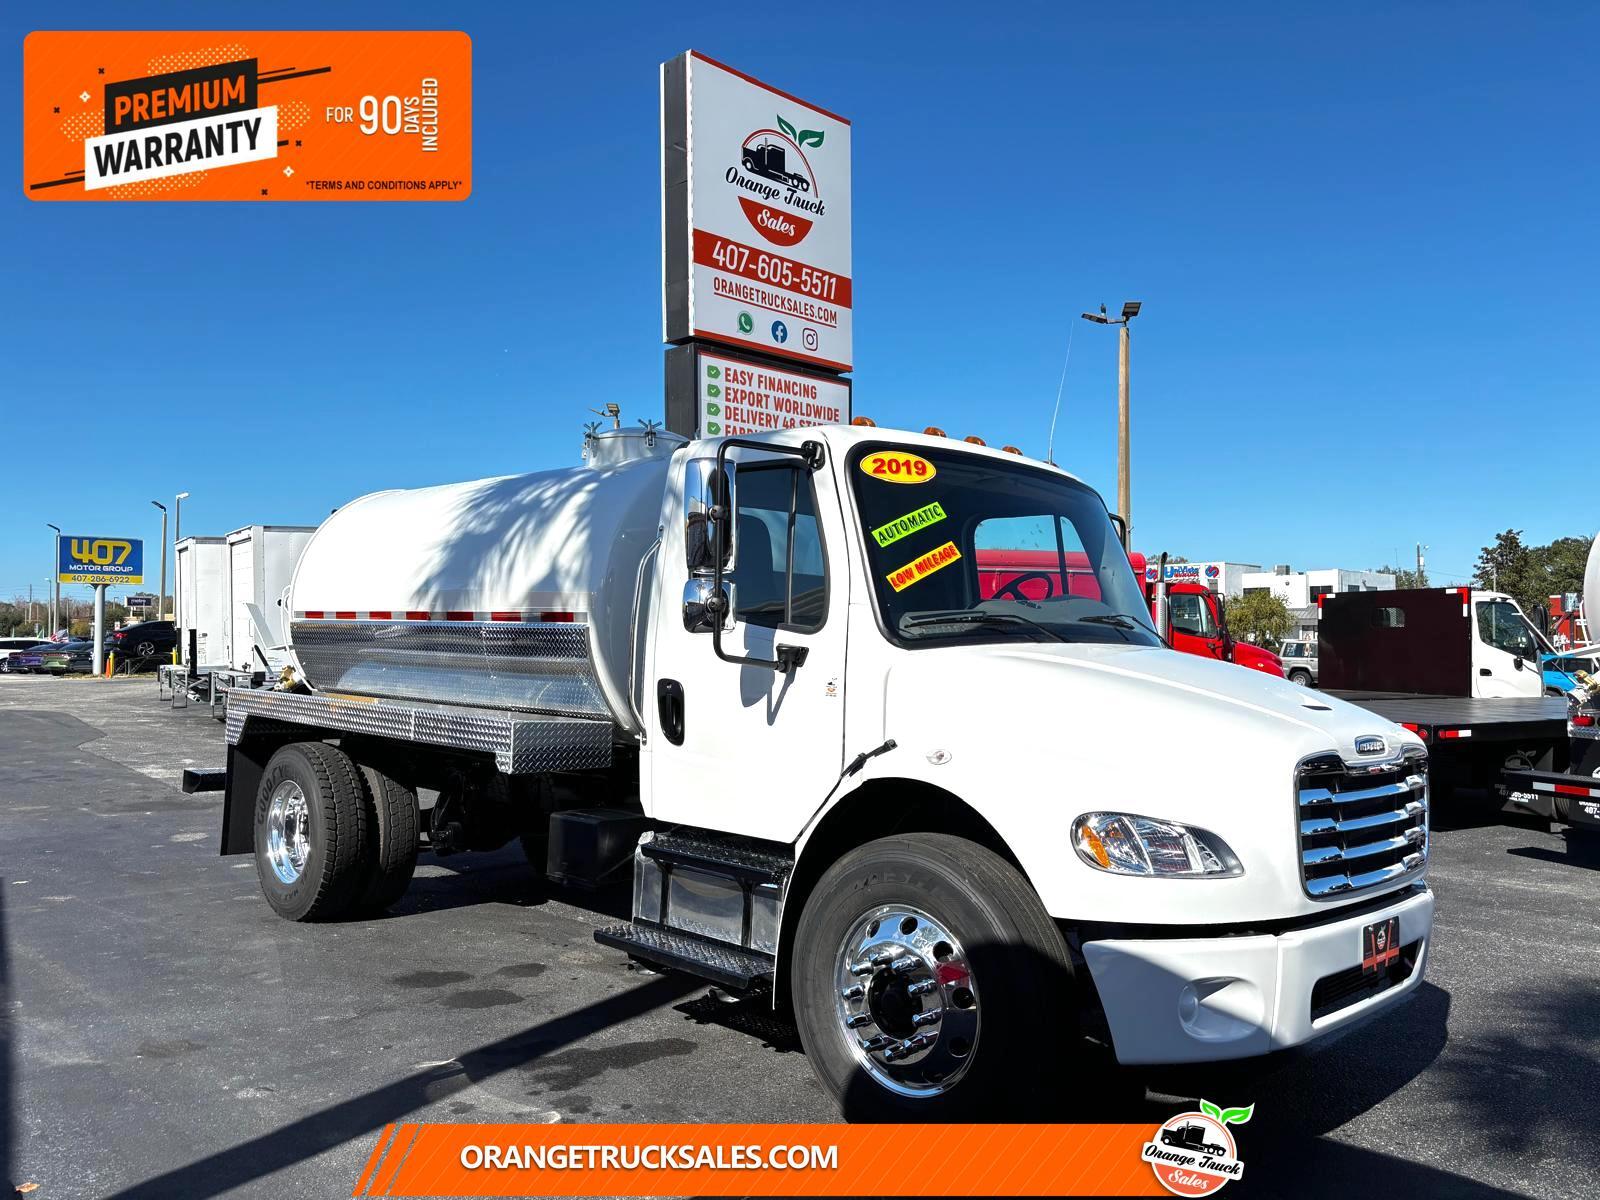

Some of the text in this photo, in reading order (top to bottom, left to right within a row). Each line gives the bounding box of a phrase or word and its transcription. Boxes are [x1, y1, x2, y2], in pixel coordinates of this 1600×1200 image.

[725, 166, 826, 216] Orange Truck
[757, 209, 796, 237] Sales
[712, 240, 837, 300] 407-605-5511
[713, 277, 838, 325] ORANGETRUCKSALES.COM
[724, 367, 817, 400] EASY FINANCING
[724, 387, 840, 422] EXPORT WORLDWIDE
[725, 405, 780, 429] DELIVERY
[872, 458, 927, 476] 2019
[878, 504, 943, 544] AUTOMATIC
[69, 564, 101, 572] MOTOR
[71, 538, 132, 565] 407
[890, 544, 958, 589] LOW MILEAGE
[72, 575, 130, 583] 407-286-6922
